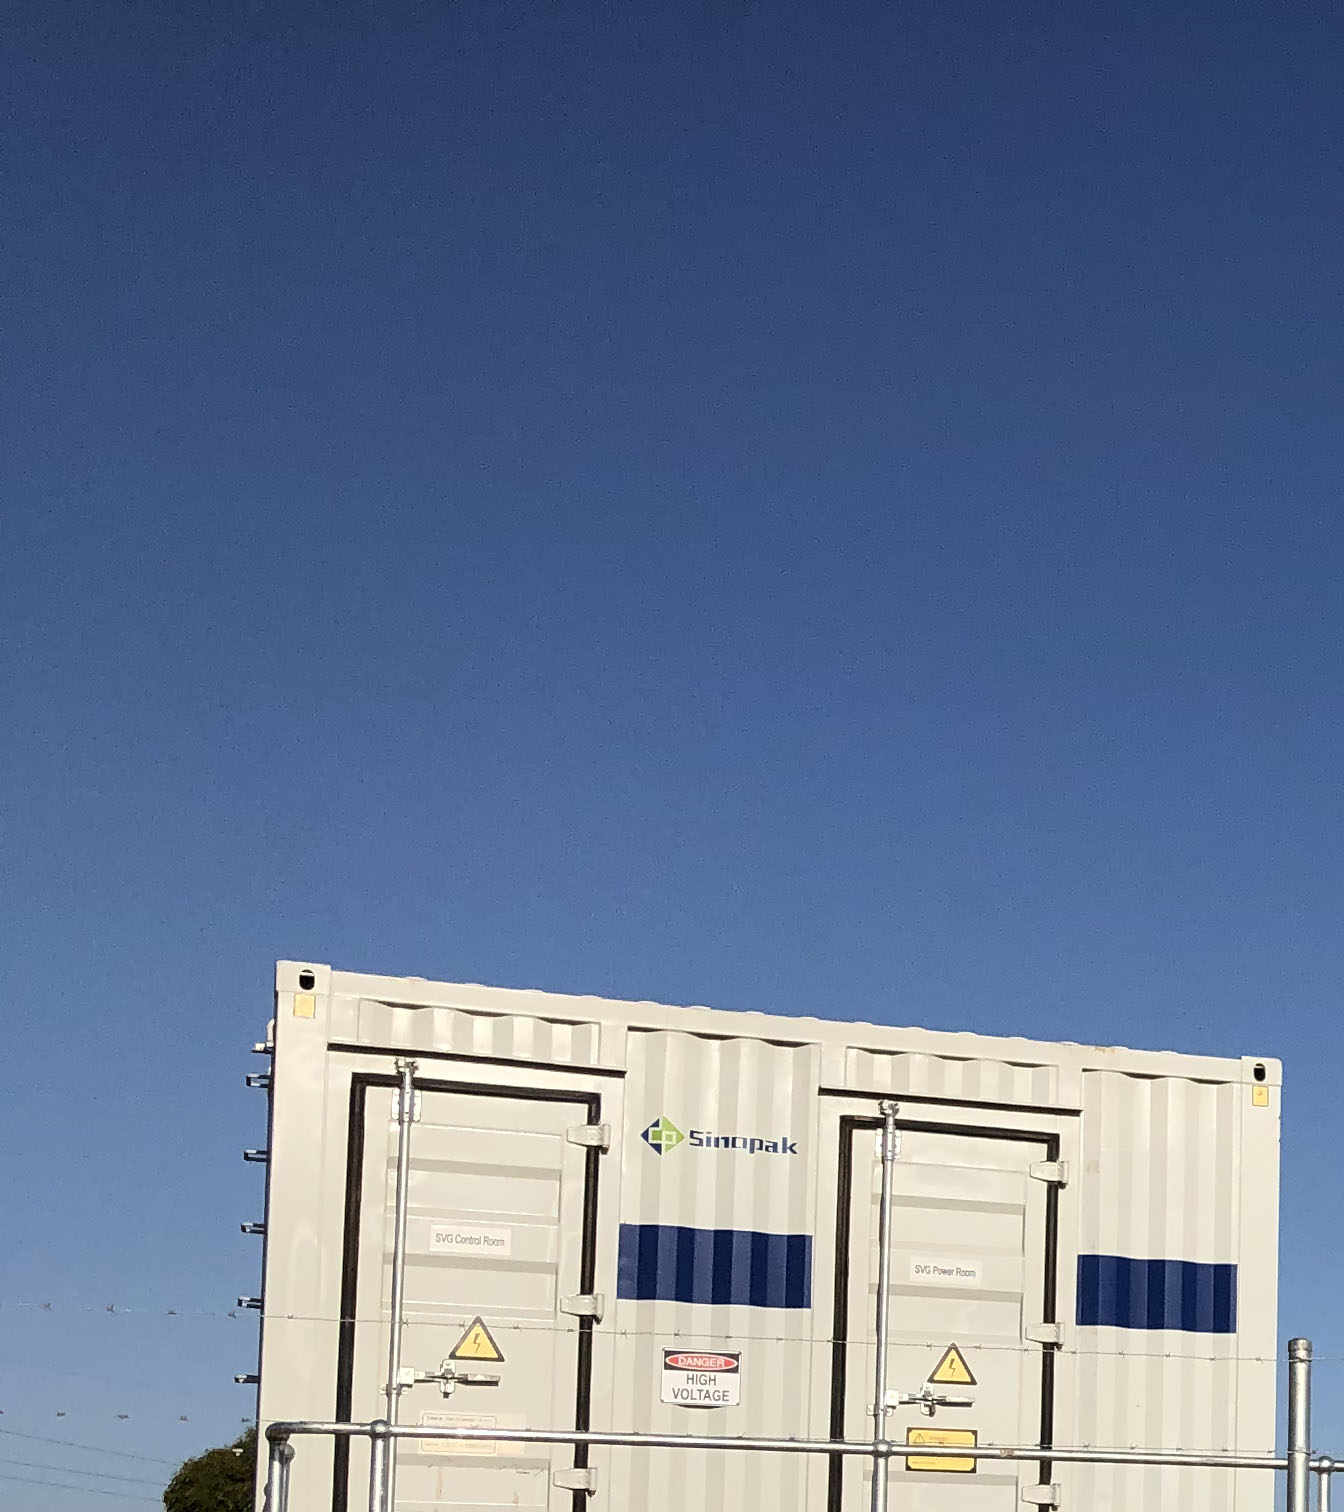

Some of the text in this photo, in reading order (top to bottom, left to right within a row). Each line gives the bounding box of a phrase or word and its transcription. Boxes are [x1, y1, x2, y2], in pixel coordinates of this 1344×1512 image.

[689, 1129, 798, 1155] Sinopak
[435, 1232, 454, 1244] SVG
[455, 1234, 482, 1245] Control
[914, 1264, 932, 1275] SVG
[678, 1356, 725, 1368] DANGER
[686, 1373, 717, 1387] HIGH
[672, 1387, 730, 1402] VOLTAGE
